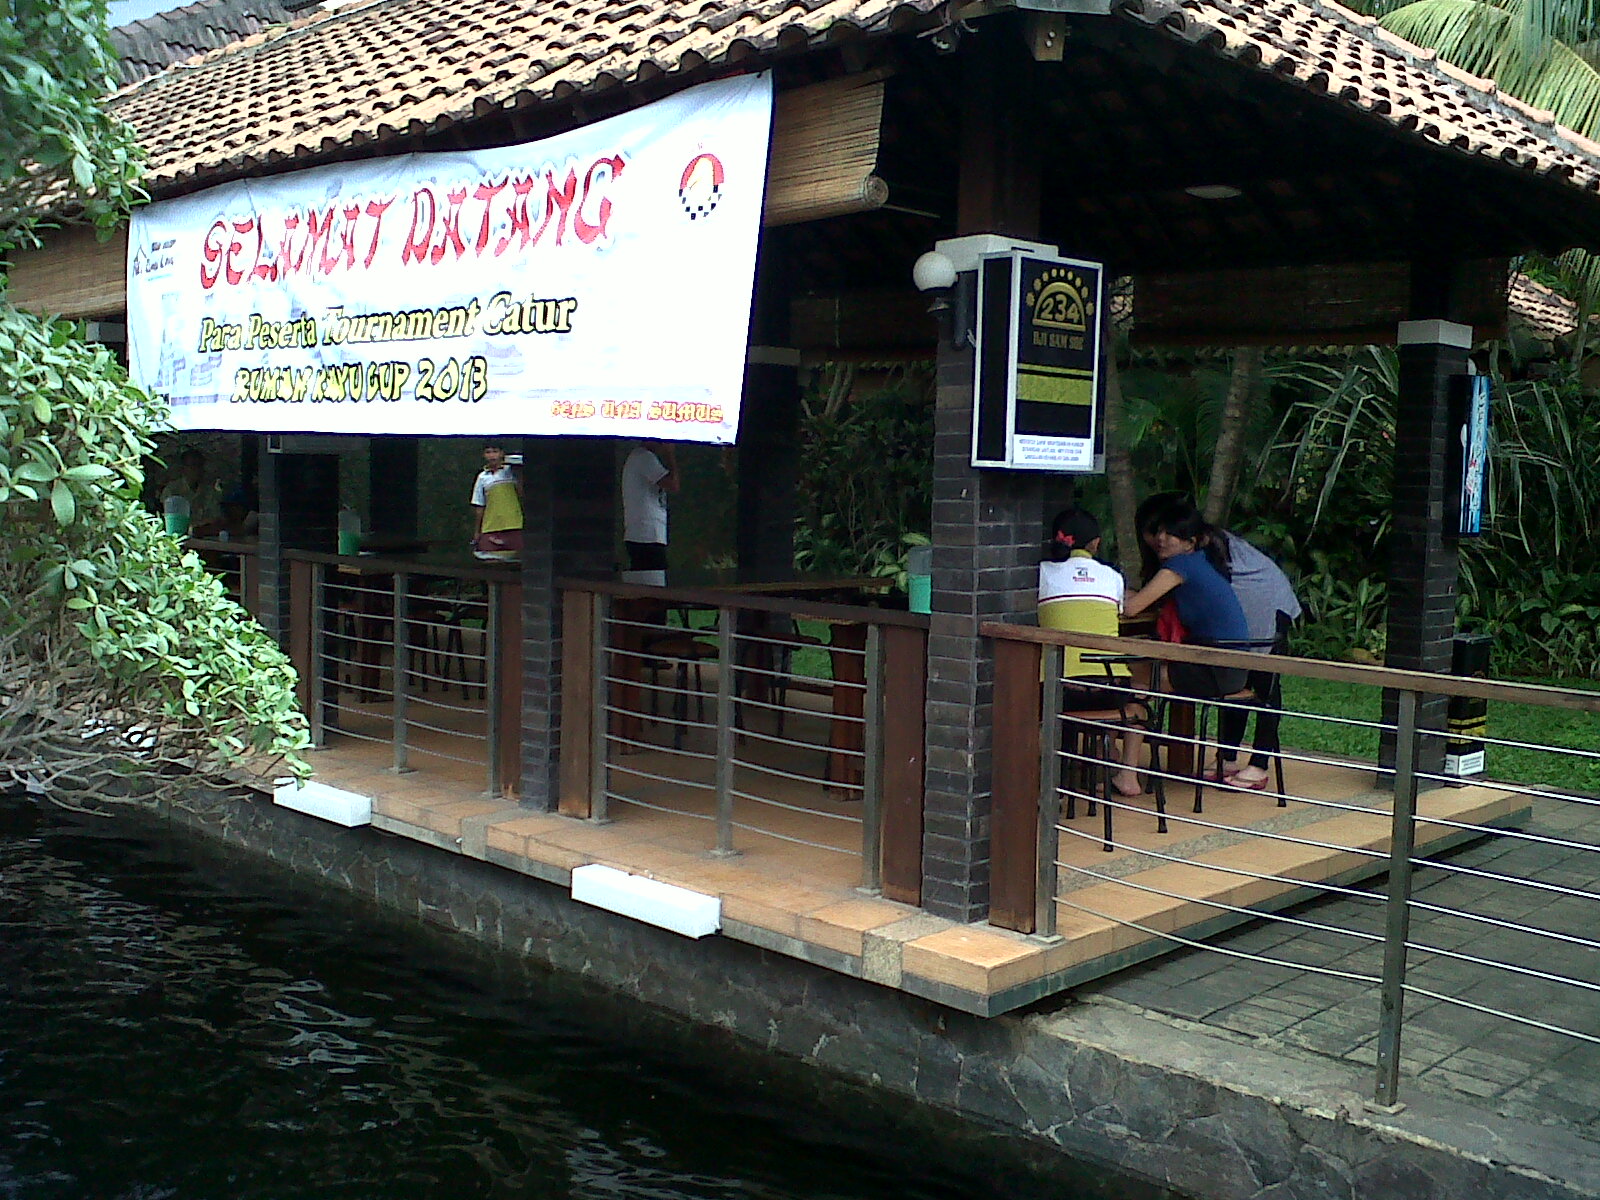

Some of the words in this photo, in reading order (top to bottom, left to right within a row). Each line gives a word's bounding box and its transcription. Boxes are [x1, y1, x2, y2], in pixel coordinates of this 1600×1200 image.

[200, 195, 398, 290] SELAMAT
[401, 153, 627, 265] DATANG
[198, 316, 243, 353] Para
[244, 311, 318, 349] Peserta
[321, 298, 481, 346] Tournament
[482, 290, 577, 335] Catur
[1041, 293, 1080, 323] 234
[366, 360, 412, 403] CUP
[414, 355, 488, 402] 2013
